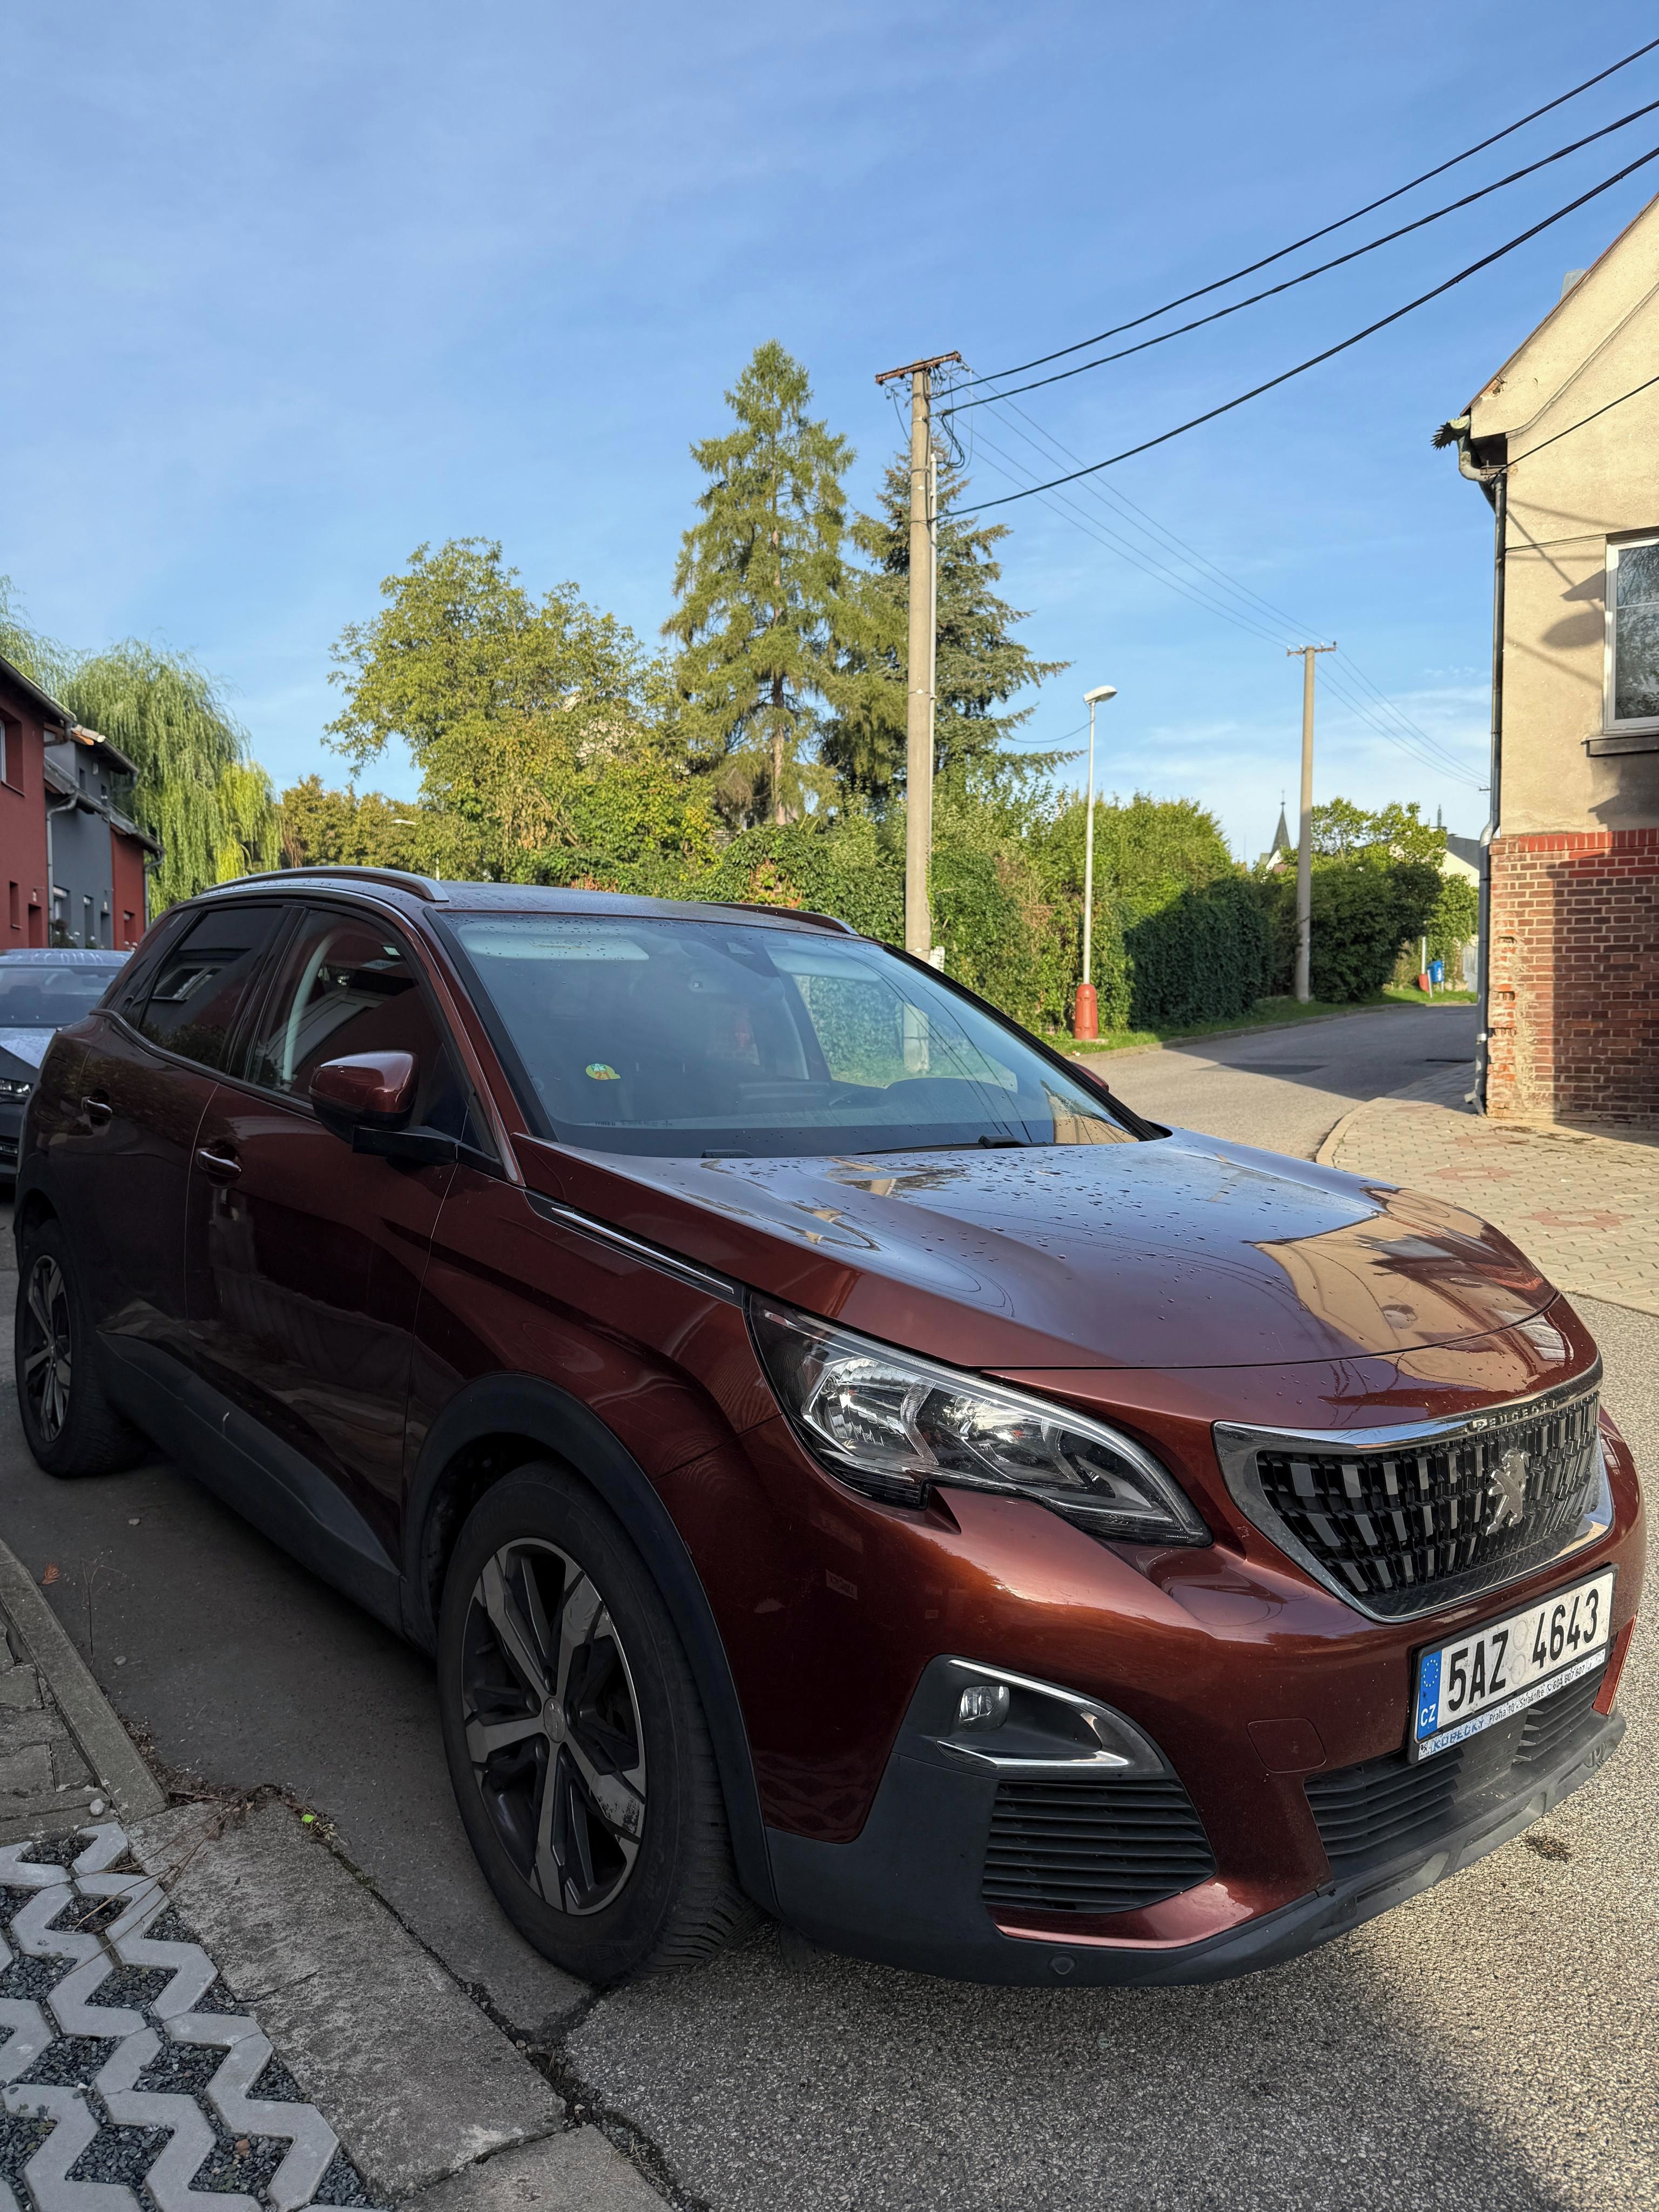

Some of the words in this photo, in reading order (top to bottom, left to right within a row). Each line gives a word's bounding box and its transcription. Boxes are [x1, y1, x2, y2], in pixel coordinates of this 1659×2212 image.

[595, 1071, 610, 1080] 21
[1475, 1400, 1547, 1432] PEUGEOT
[1448, 1629, 1509, 1711] 5AZ
[1532, 1589, 1599, 1668] 4643
[1420, 1703, 1435, 1727] CZ
[1489, 1709, 1506, 1723] Praha
